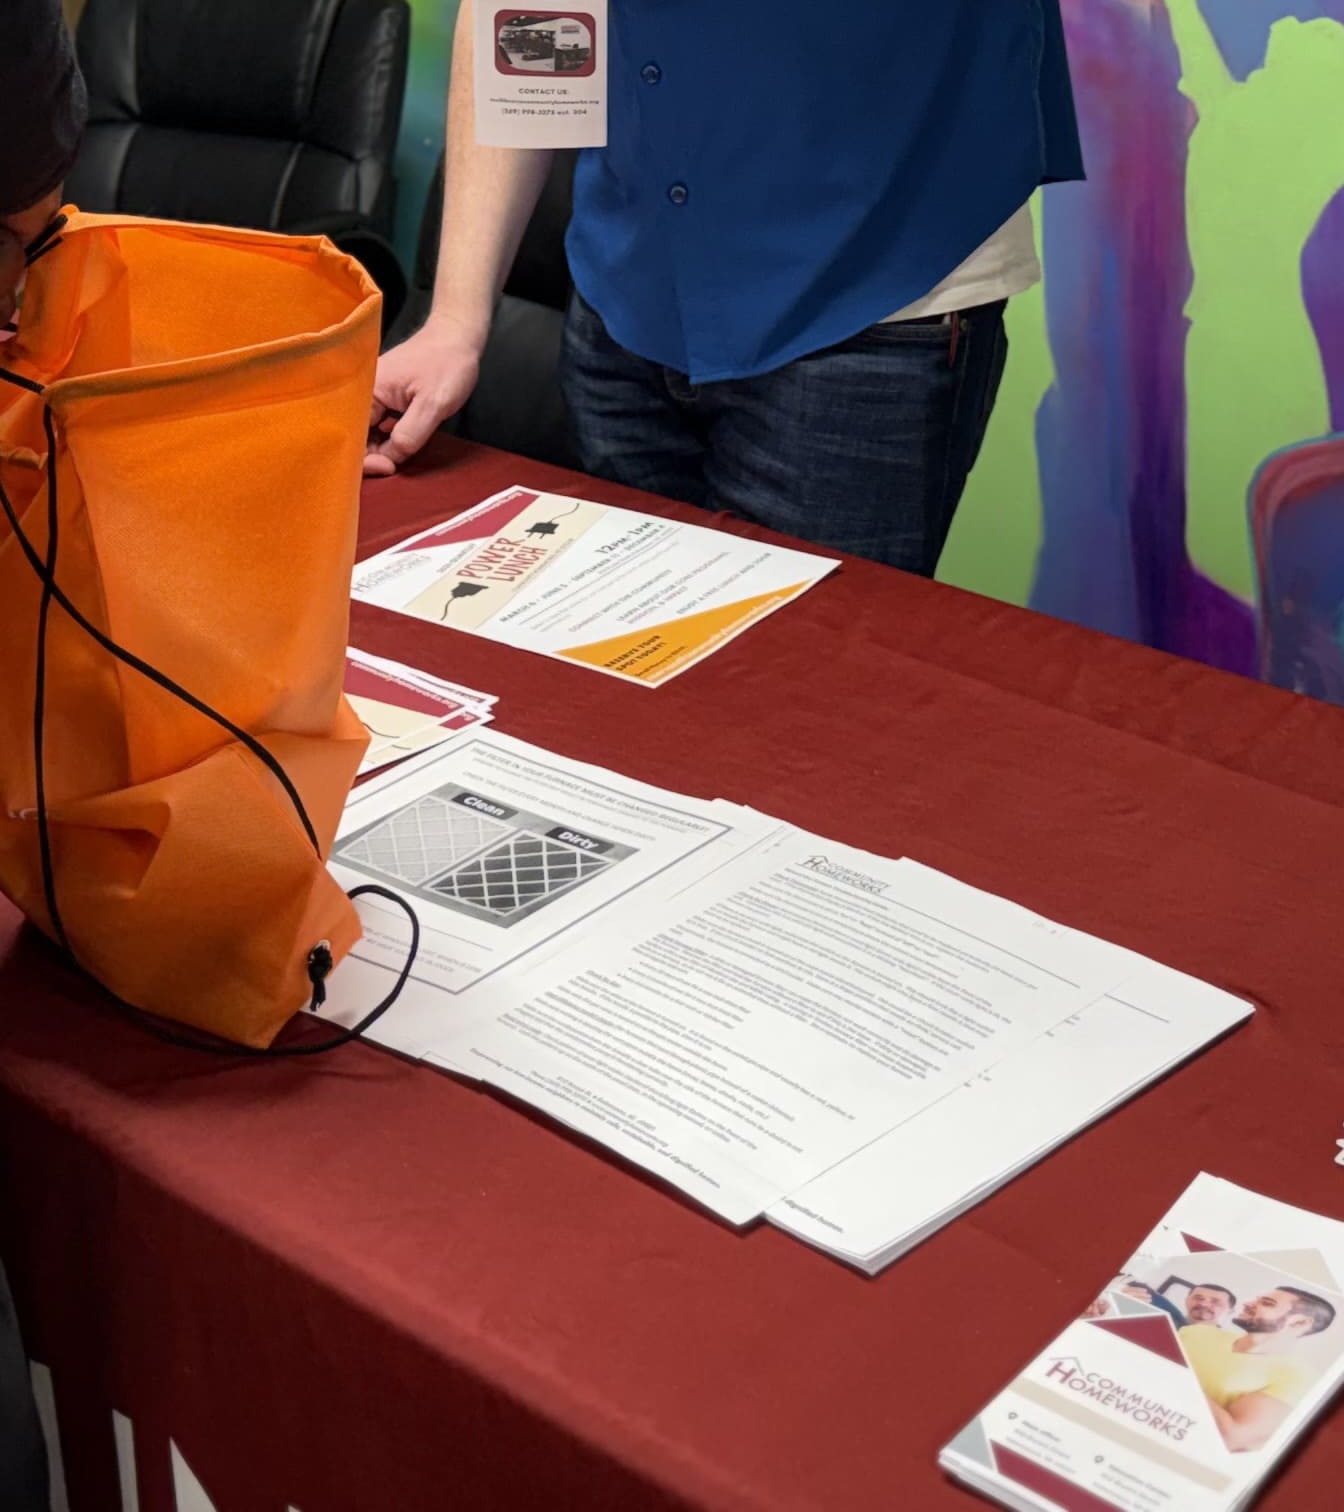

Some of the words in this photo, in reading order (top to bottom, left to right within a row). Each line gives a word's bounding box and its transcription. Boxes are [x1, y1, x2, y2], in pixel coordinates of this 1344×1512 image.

[456, 537, 527, 580] POWER
[487, 546, 548, 583] LUNCH
[463, 795, 505, 818] Clean
[558, 830, 600, 850] Dirty
[1045, 1361, 1188, 1441] HOMEWORKS
[1086, 1372, 1197, 1429] COMMUNITY
